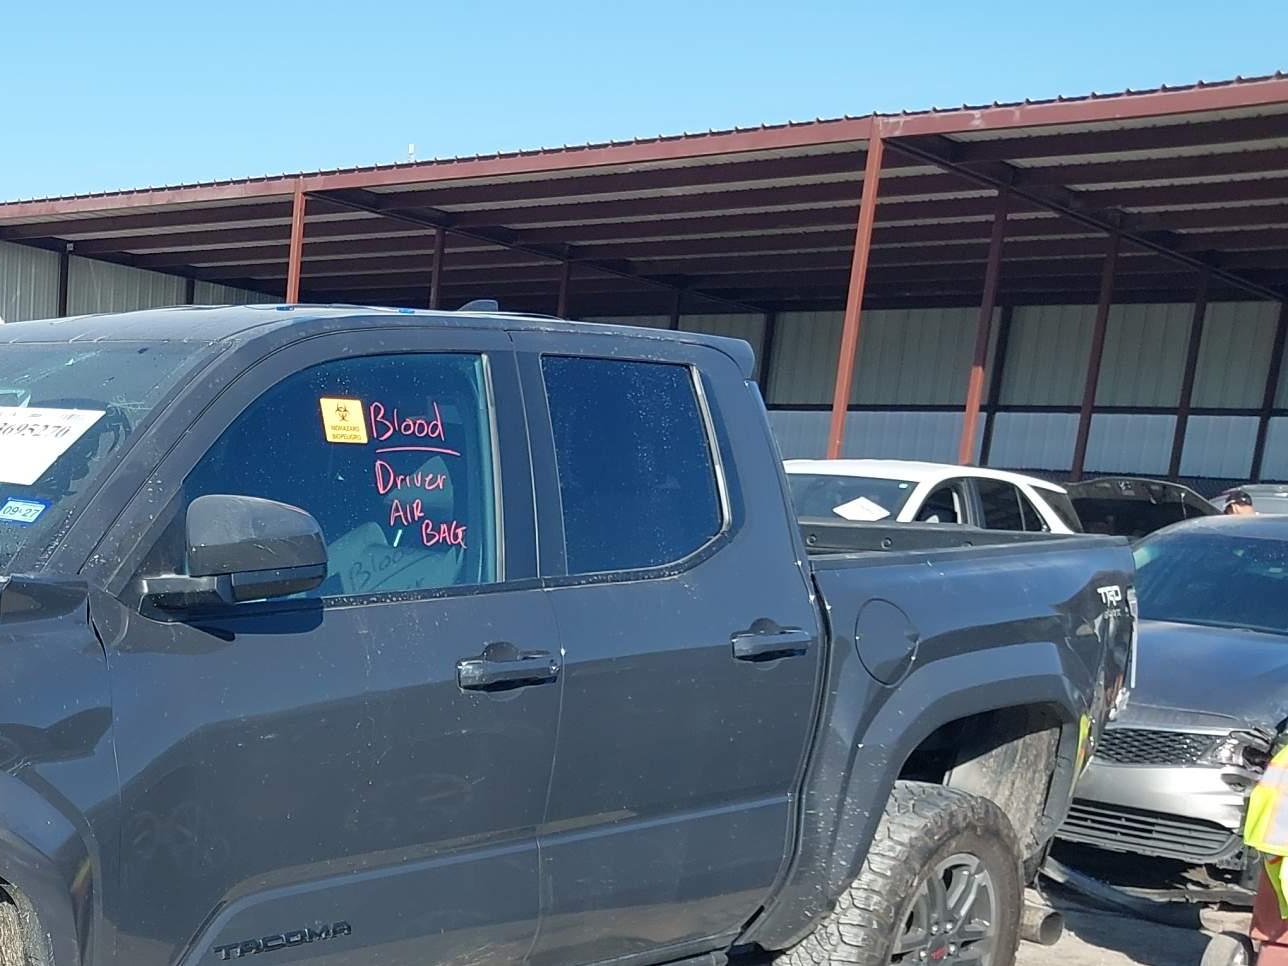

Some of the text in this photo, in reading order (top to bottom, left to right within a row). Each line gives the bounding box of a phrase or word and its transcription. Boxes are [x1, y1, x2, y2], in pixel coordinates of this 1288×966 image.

[370, 401, 445, 441] Blood
[375, 459, 446, 494] Driver
[390, 499, 467, 549] AIR BAG
[1097, 585, 1122, 607] TRD
[213, 920, 352, 960] TACOMA
